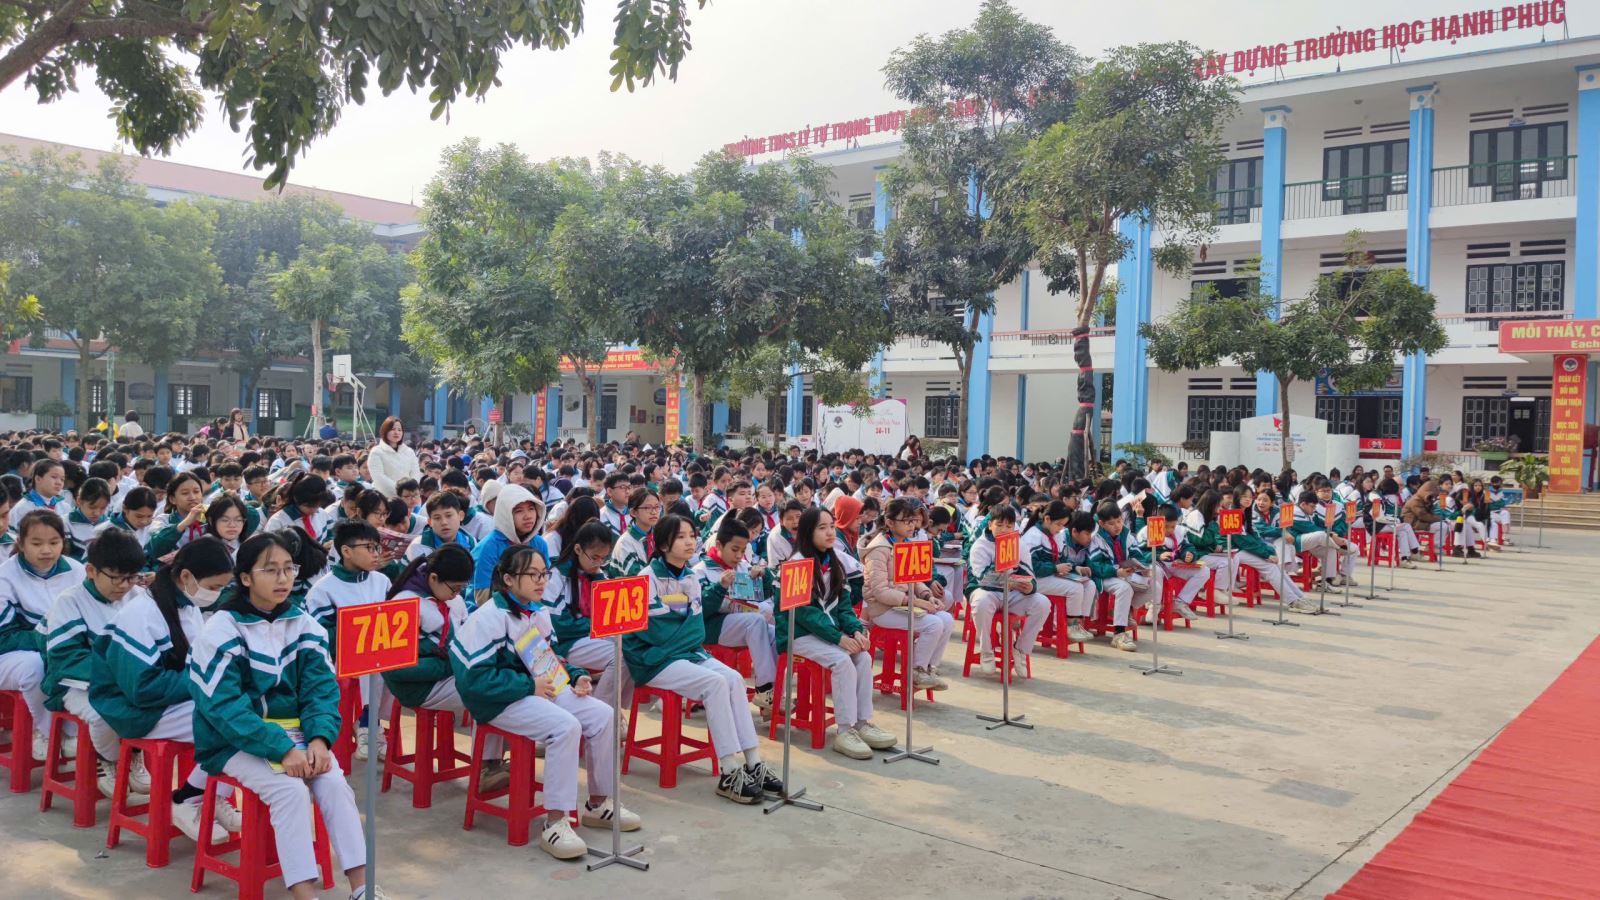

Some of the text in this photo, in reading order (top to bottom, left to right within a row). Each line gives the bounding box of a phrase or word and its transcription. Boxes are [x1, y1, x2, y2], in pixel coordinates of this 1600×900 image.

[1234, 44, 1288, 77] DỰNG
[1382, 20, 1425, 53] HỌC
[1431, 9, 1494, 45] HẠNH
[1223, 513, 1240, 529] 6A5
[897, 545, 931, 577] 7A5
[1000, 538, 1018, 564] 6A1
[785, 566, 808, 598] 7A4
[600, 586, 644, 626] 7A3
[353, 610, 409, 655] 7A2
